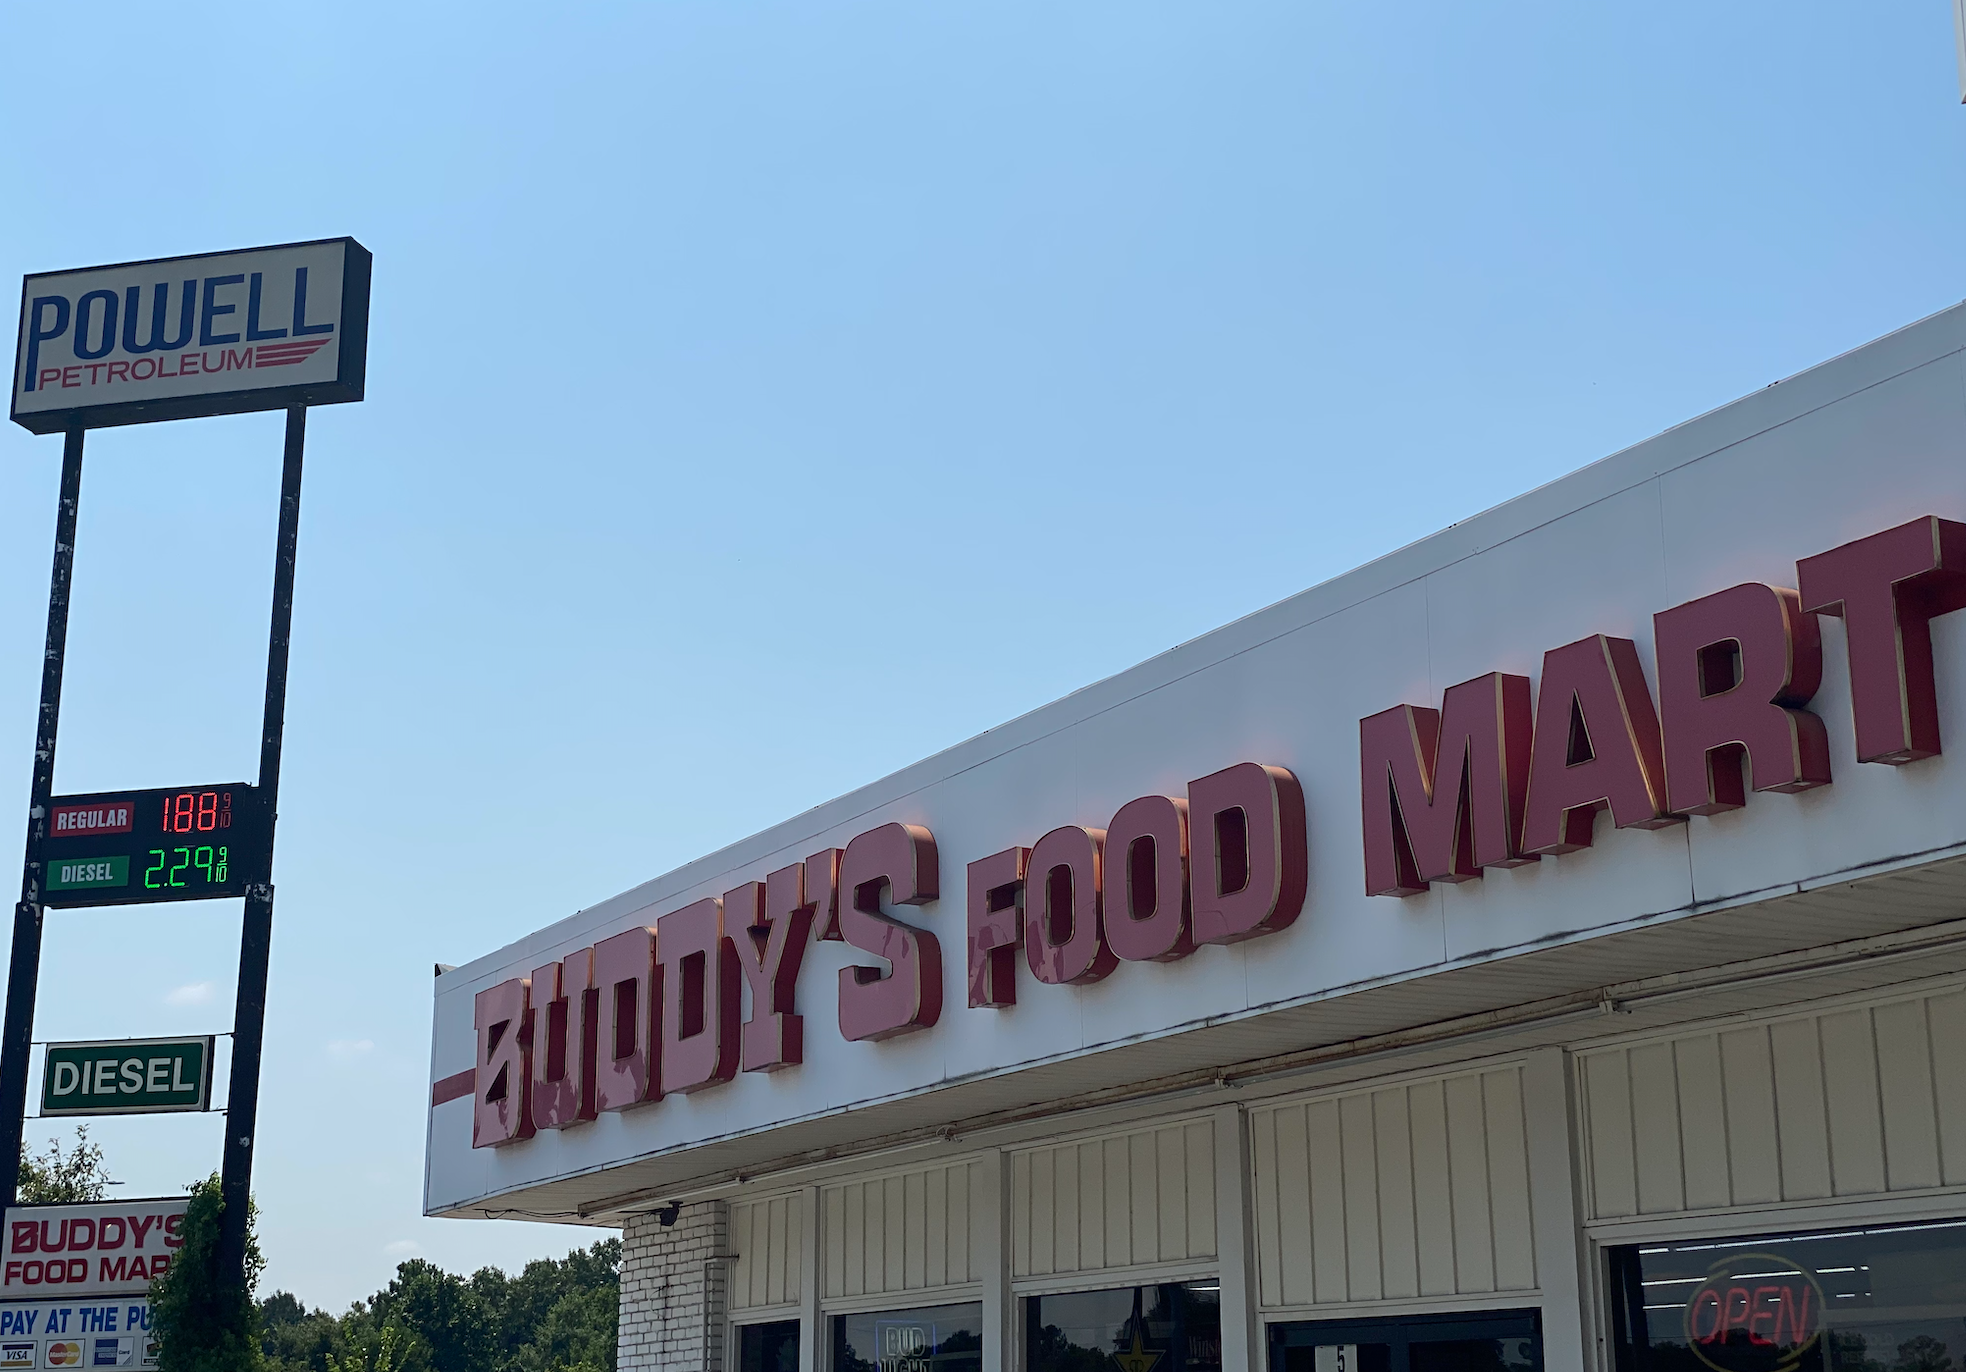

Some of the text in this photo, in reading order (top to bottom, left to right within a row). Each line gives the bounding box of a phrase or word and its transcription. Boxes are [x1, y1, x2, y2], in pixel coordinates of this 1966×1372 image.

[24, 267, 334, 392] POWELL
[38, 347, 253, 391] PETROLEUM
[56, 808, 128, 831] REGULAR
[473, 514, 1966, 1149] BUDDY'S FOOD MART
[60, 863, 114, 884] DIESEL
[52, 1056, 195, 1096] DIESEL
[11, 1214, 187, 1254] BUDDY'S
[4, 1254, 172, 1286] FOOD MAR
[0, 1309, 39, 1336] PAY
[45, 1308, 72, 1334] AT
[79, 1306, 119, 1333] THE
[1691, 1285, 1810, 1345] OPEN
[6, 1350, 28, 1361] VISA
[885, 1326, 926, 1357] BUD
